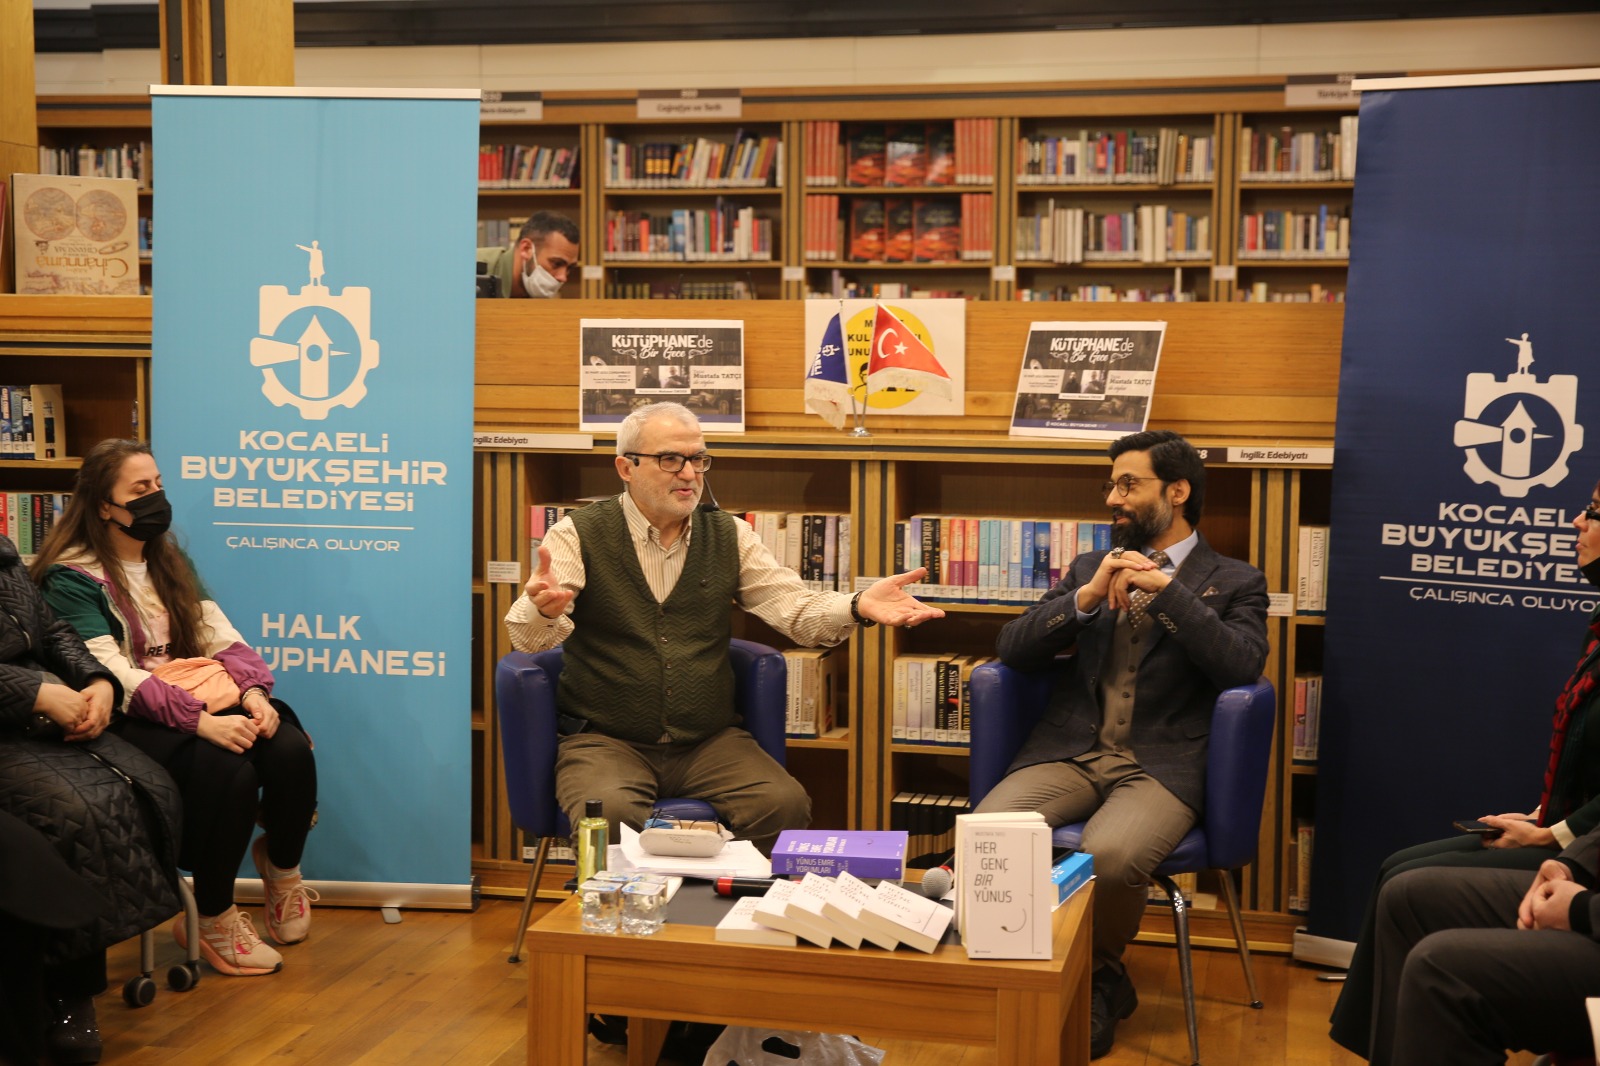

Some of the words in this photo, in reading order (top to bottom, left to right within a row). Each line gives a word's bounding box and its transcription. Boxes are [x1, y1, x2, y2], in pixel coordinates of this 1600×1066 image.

[1267, 451, 1308, 462] Edebiyatı
[1438, 502, 1584, 528] KOCAEL
[226, 536, 319, 550] ÇALIŞINCA
[325, 538, 400, 552] OLUYOR
[1381, 523, 1578, 559] BÜYÜKŞE
[1411, 553, 1590, 584] BELEDİYE
[1409, 587, 1515, 607] ÇALIŞINCA
[261, 612, 361, 640] HALK
[974, 841, 998, 855] HER
[980, 857, 1009, 874] GENÇ
